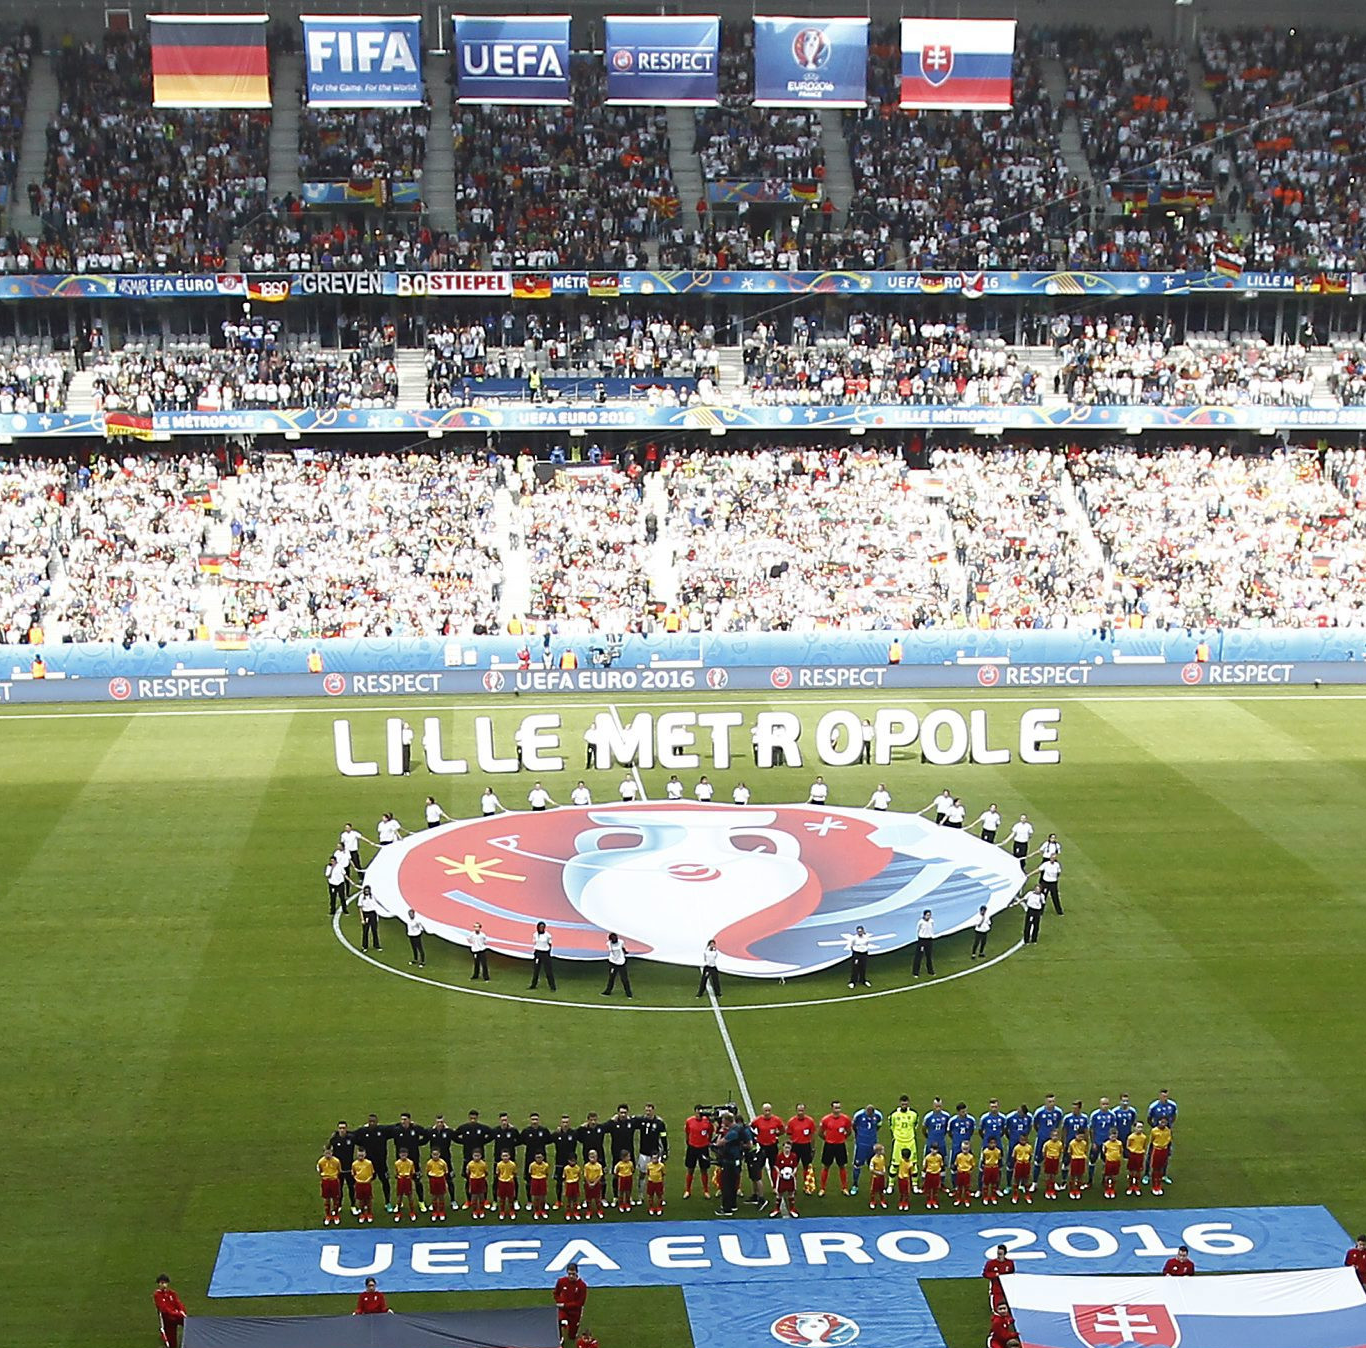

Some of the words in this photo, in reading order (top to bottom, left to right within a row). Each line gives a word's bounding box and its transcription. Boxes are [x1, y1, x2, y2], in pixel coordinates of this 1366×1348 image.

[308, 32, 417, 72] FIFA
[463, 45, 563, 76] UEFA
[638, 53, 714, 71] RESPECT
[312, 83, 323, 92] For
[325, 83, 337, 92] the
[365, 83, 377, 92] For
[379, 83, 392, 92] the
[176, 278, 215, 292] EURO
[258, 281, 288, 296] 1860
[303, 273, 382, 294] GREVEN
[430, 275, 507, 291] STIEPEL
[1247, 276, 1280, 288] LILLE
[172, 412, 255, 429] MÉTROPOLE
[518, 413, 557, 426] UEFA
[558, 412, 598, 425] EURO
[598, 411, 635, 424] 2016
[894, 411, 930, 424] LILLE
[932, 406, 1012, 424] MÉTROPOLE
[1298, 411, 1337, 426] EURO
[352, 672, 442, 694] RESPECT
[516, 671, 575, 691] UEFA
[577, 671, 637, 690] EURO
[641, 669, 695, 689] 2016
[799, 667, 887, 687] RESPECT
[1006, 665, 1092, 685] RESPECT
[1209, 663, 1294, 684] RESPECT
[138, 677, 228, 699] RESPECT
[333, 713, 565, 777] LILLE
[592, 708, 1062, 770] METROPOLE
[319, 1238, 622, 1277] UEFA
[647, 1229, 952, 1271] EURO
[977, 1221, 1256, 1260] 2016
